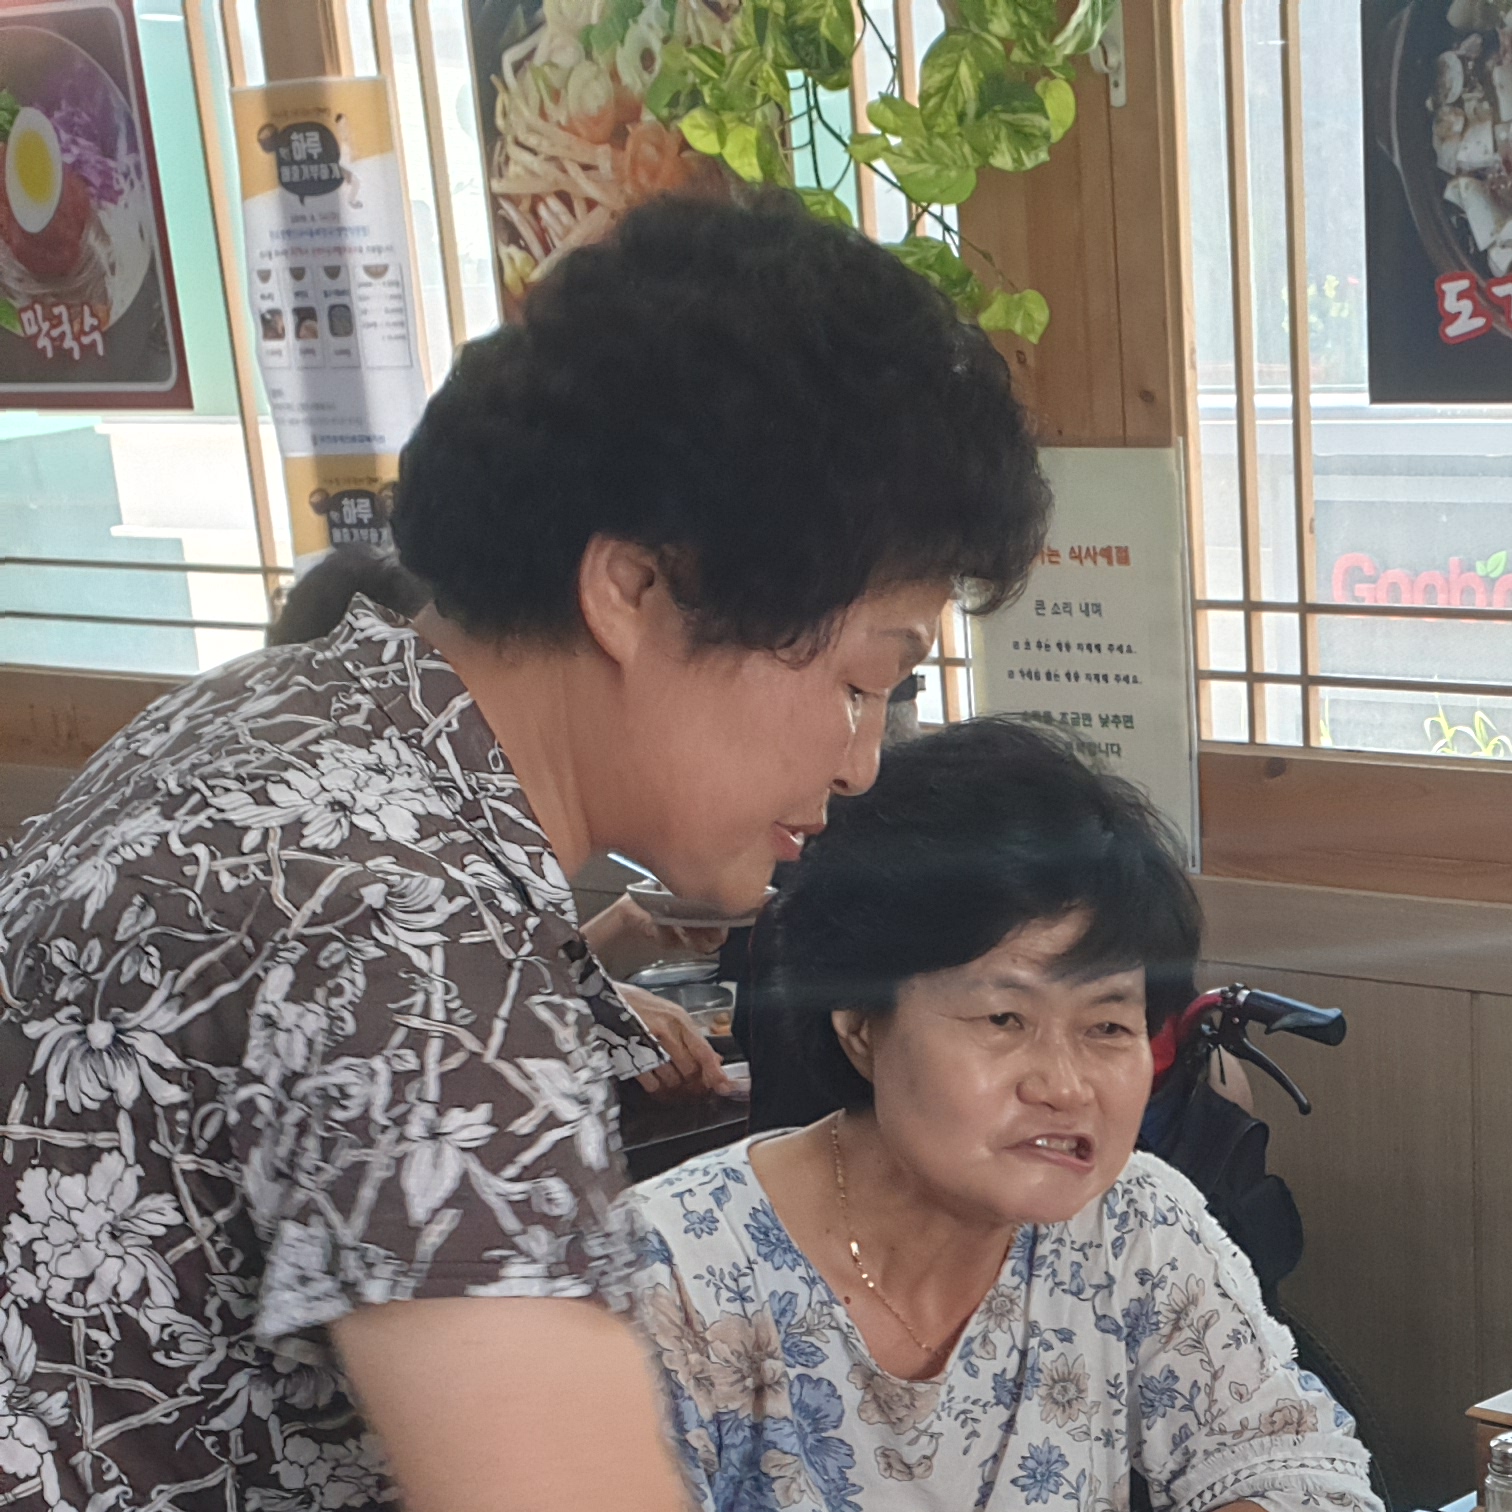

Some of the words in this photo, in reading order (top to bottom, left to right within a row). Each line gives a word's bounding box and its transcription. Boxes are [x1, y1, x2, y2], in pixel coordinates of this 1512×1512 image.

[20, 303, 104, 360] 막국수
[1035, 600, 1046, 616] 큰
[1051, 601, 1073, 617] 소리
[1079, 602, 1103, 617] 내며
[1098, 713, 1135, 729] 낮추면
